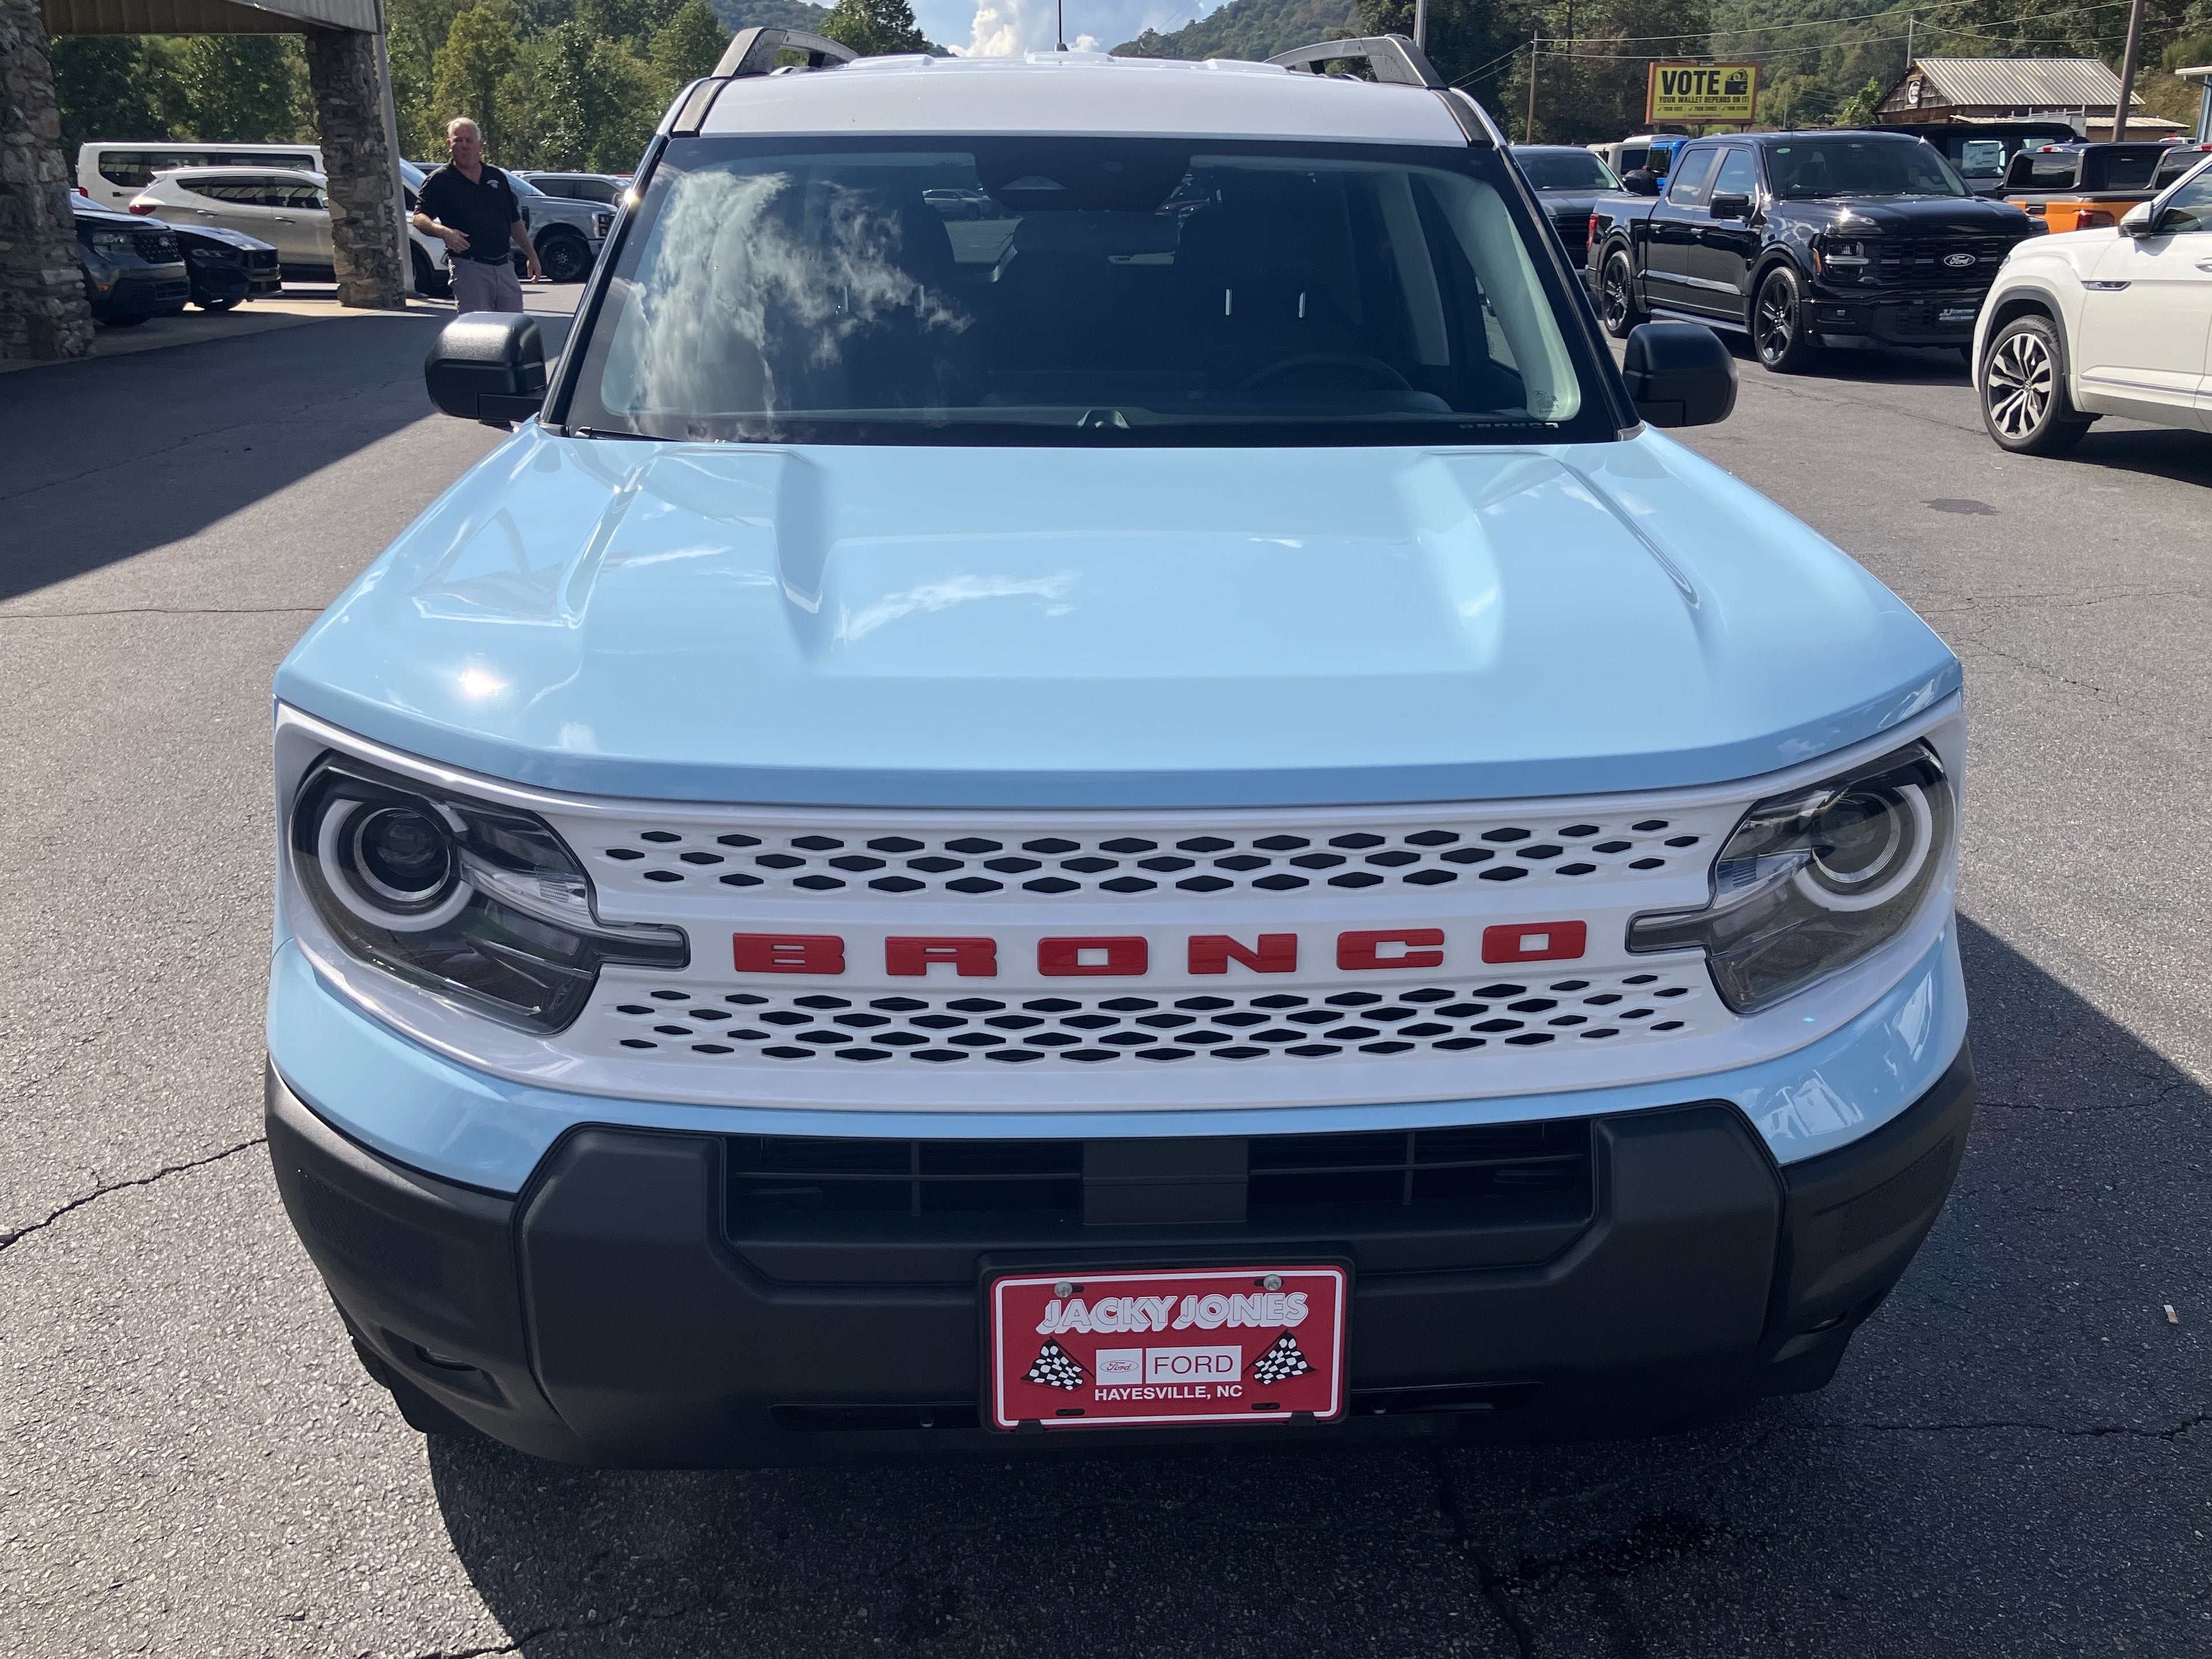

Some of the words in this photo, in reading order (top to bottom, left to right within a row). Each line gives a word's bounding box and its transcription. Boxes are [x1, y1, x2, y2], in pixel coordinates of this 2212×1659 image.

[1661, 70, 1720, 96] VOTE
[1659, 96, 1676, 104] YOUR
[1678, 96, 1703, 104] WALLET
[1704, 96, 1731, 104] DEPENDS
[1732, 96, 1741, 104] ON
[1949, 255, 1971, 265] Ford
[732, 919, 1587, 976] BRONCO
[1036, 1295, 1177, 1335] JACKY
[1172, 1292, 1309, 1330] JONES
[1105, 1360, 1133, 1371] Ford
[1154, 1355, 1233, 1375] FORD
[1094, 1386, 1211, 1401] HAYESVILLE,
[1216, 1385, 1243, 1398] NC
